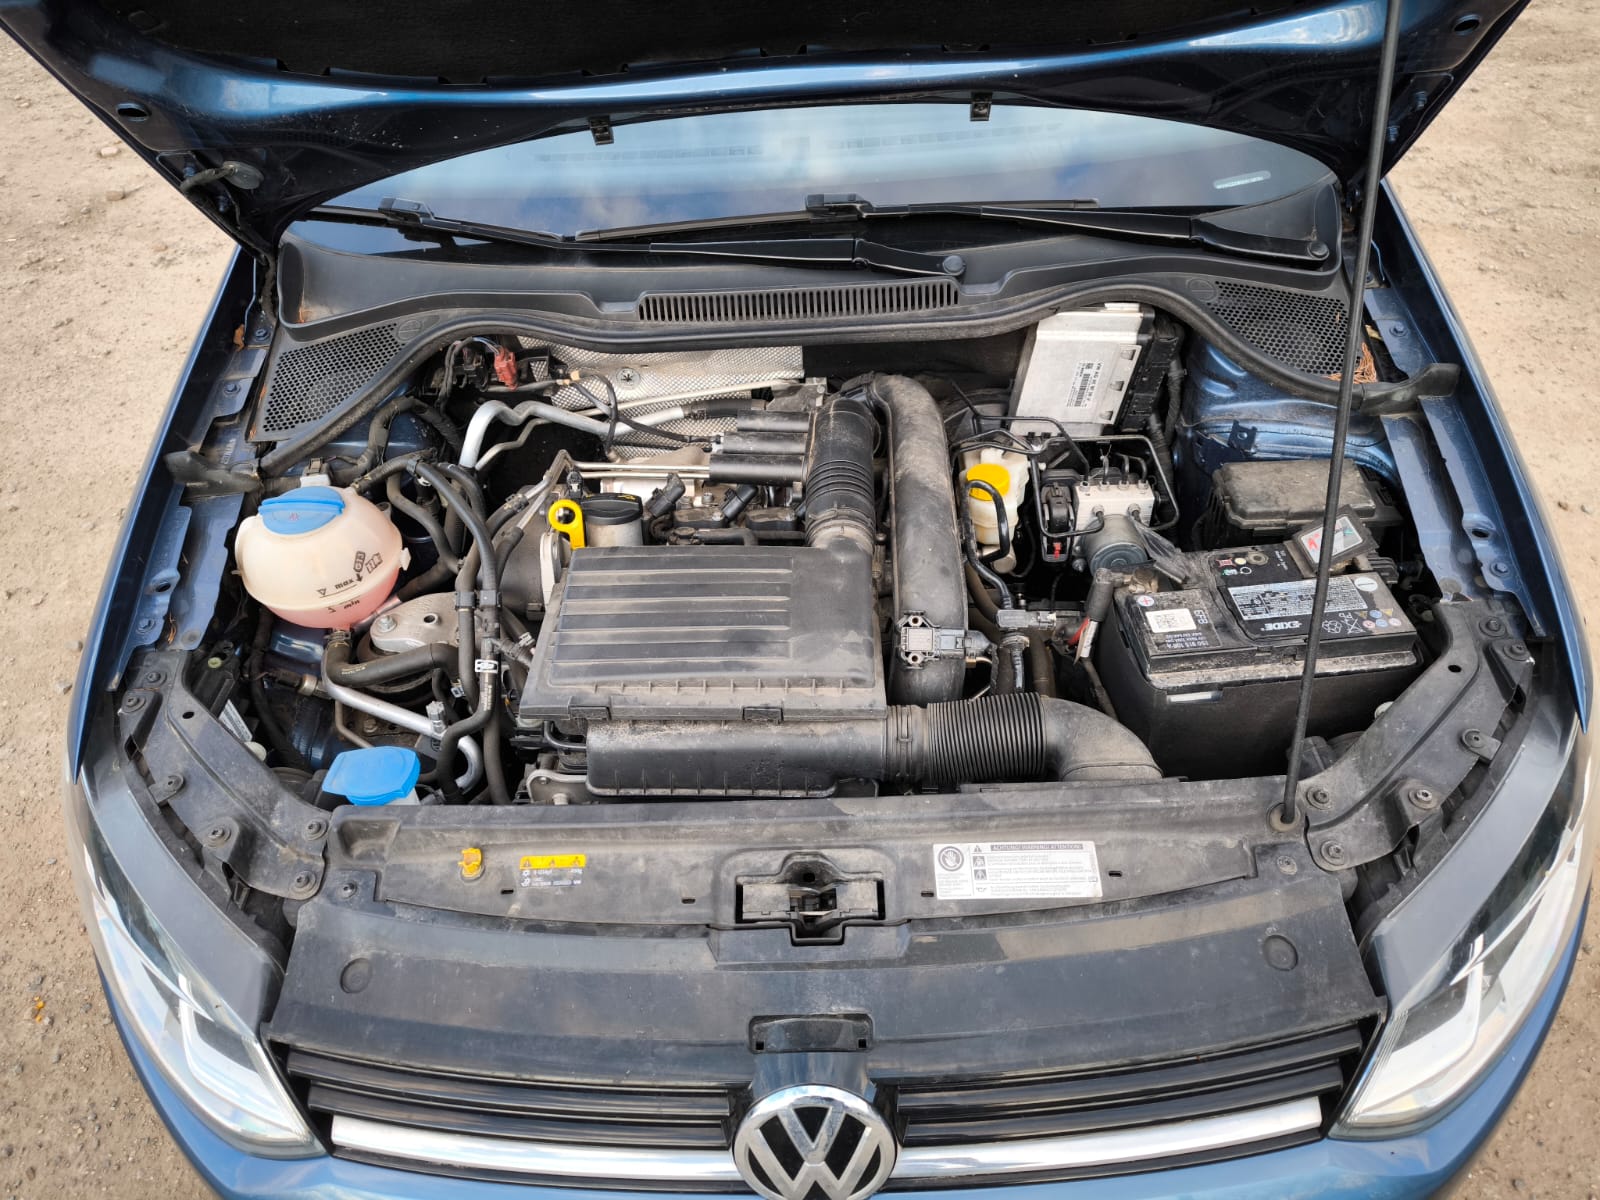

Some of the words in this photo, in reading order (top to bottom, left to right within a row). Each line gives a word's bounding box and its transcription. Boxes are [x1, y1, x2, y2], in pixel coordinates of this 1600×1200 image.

[335, 578, 354, 589] max
[343, 599, 360, 609] min
[1264, 620, 1302, 631] EXIDE
[738, 1088, 892, 1200] VW
